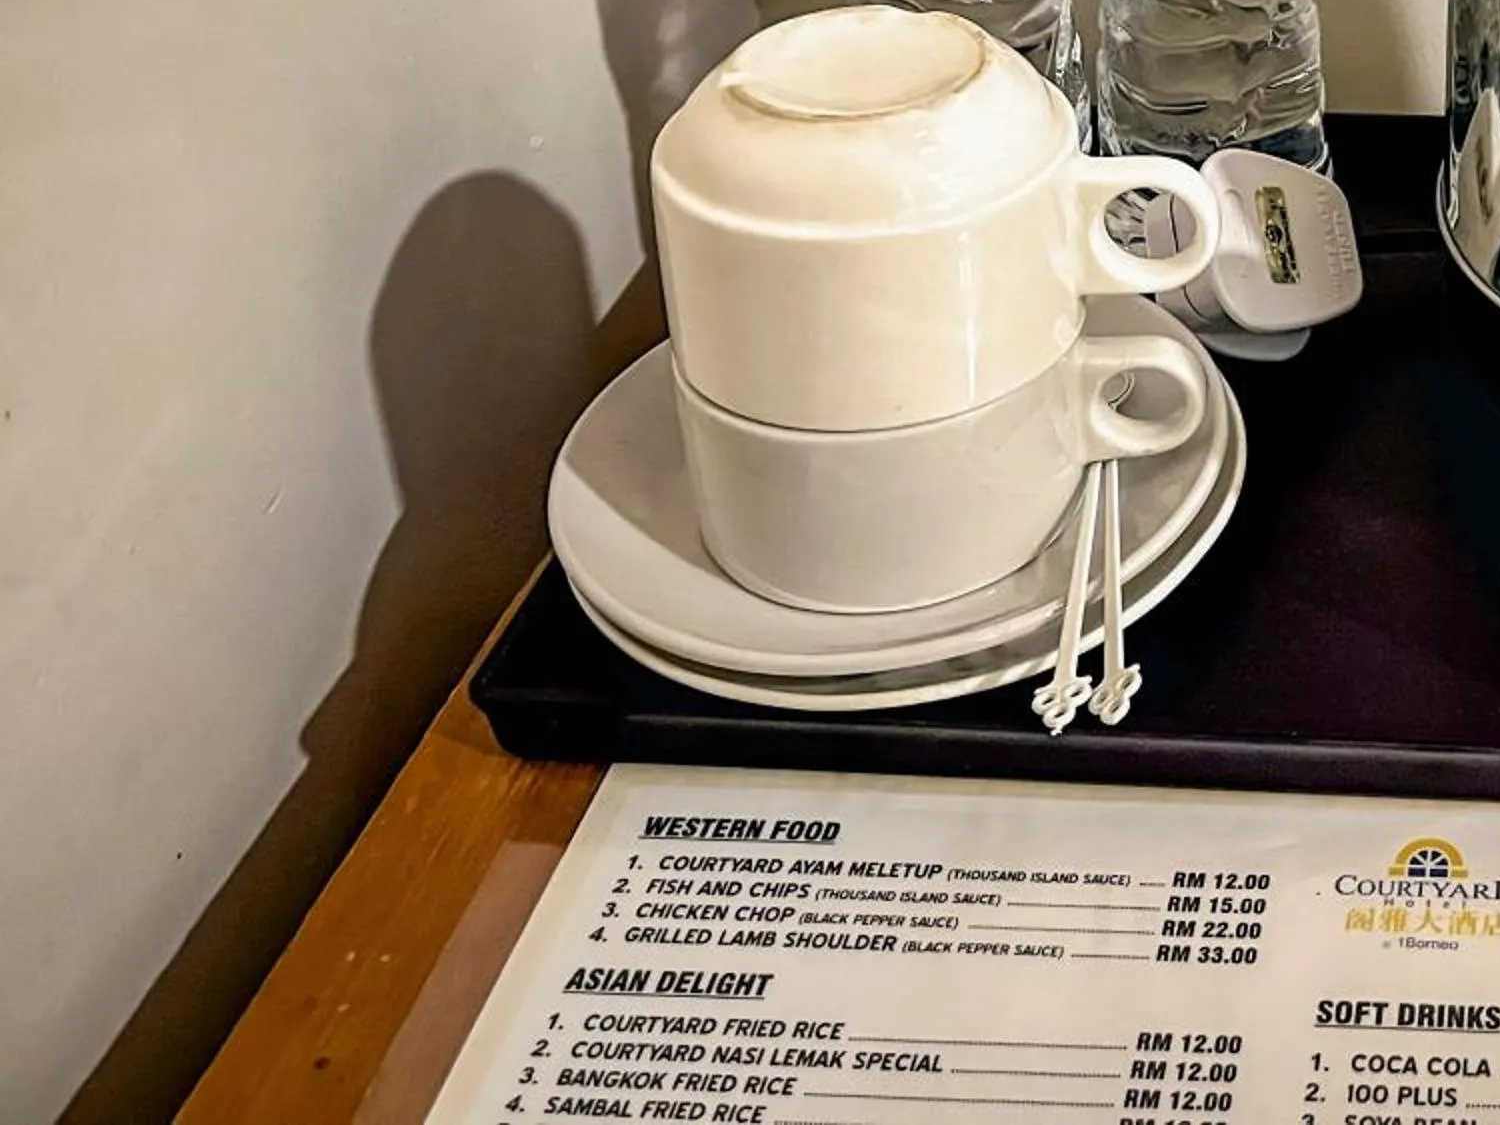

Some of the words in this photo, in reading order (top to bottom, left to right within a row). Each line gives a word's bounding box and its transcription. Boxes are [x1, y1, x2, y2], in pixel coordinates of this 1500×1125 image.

[643, 816, 766, 839] WESTERN
[769, 820, 840, 842] FOOD
[659, 855, 783, 875] COURTYARD
[788, 859, 844, 876] AYAM
[847, 862, 943, 880] MELETUP
[947, 867, 1026, 884] (THOUSAND
[1031, 870, 1079, 884] ISLAND
[1083, 872, 1131, 888] SAUCE)
[1172, 872, 1206, 890] RM
[1214, 873, 1271, 891] 12.00
[645, 878, 693, 895] FISH
[697, 880, 742, 897] AND
[748, 881, 812, 899] CHIPS
[815, 887, 897, 903] (THOUSAND
[900, 891, 948, 905] ISLAND
[952, 892, 1002, 907] SAUCE)
[1167, 896, 1201, 914] RM
[1209, 897, 1267, 915] 15.00
[636, 902, 729, 921] CHICKEN
[734, 905, 796, 923] CHOP
[799, 912, 848, 927] (BLACK
[853, 914, 905, 928] PEPPER
[910, 915, 960, 931] SAUCE)
[624, 926, 713, 945] GRILLED
[717, 929, 777, 947] LAMB
[783, 931, 898, 952] SHOULDER
[901, 938, 953, 954] (BLACK
[957, 941, 1011, 956] PEPPER
[1014, 943, 1065, 960] SAUCE)
[1161, 920, 1196, 938] RM
[1202, 922, 1262, 940] 22.00
[1155, 944, 1190, 963] RM
[1197, 946, 1257, 965] 33.00
[565, 967, 651, 992] ASIAN
[655, 971, 774, 997] DELIGHT
[1316, 1000, 1389, 1026] SOFT
[583, 1013, 717, 1036] COURTYARD
[722, 1018, 785, 1038] FRIED
[791, 1020, 845, 1042] RICE
[1136, 1032, 1173, 1052] RM
[1181, 1033, 1244, 1055] 12.00
[570, 1040, 706, 1063] COURTYARD
[711, 1045, 766, 1066] NASI
[769, 1048, 844, 1071] LEMAK
[851, 1051, 944, 1074] SPECIAL
[1351, 1054, 1418, 1075] COCA
[1427, 1057, 1491, 1077] COLA
[556, 1067, 665, 1091] BANGKOK
[671, 1071, 737, 1093] FRIED
[743, 1075, 798, 1096] RICE
[1130, 1060, 1168, 1081] RM
[1175, 1061, 1238, 1083] 12.00
[1123, 1088, 1161, 1109] RM
[1169, 1090, 1233, 1113] 12.00
[1397, 1086, 1458, 1107] PLUS
[543, 1095, 634, 1119] SAMBAL
[639, 1099, 707, 1122] FRIED
[711, 1102, 768, 1125] RICE
